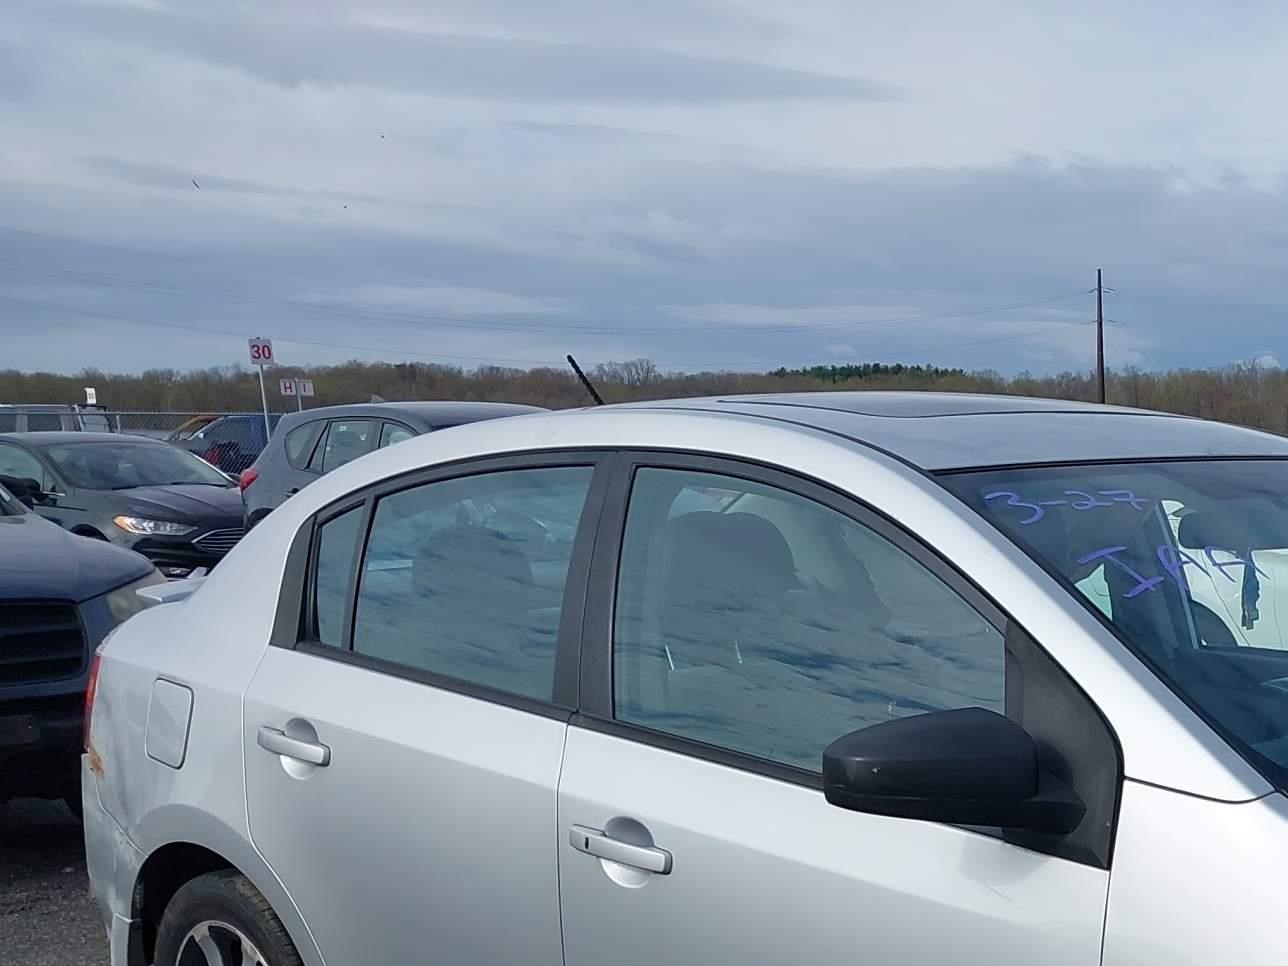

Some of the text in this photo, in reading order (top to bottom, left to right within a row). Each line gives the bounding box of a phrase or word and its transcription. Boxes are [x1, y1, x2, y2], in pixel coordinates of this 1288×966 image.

[251, 344, 271, 360] 30
[284, 381, 292, 393] H
[984, 490, 1149, 525] 3-27
